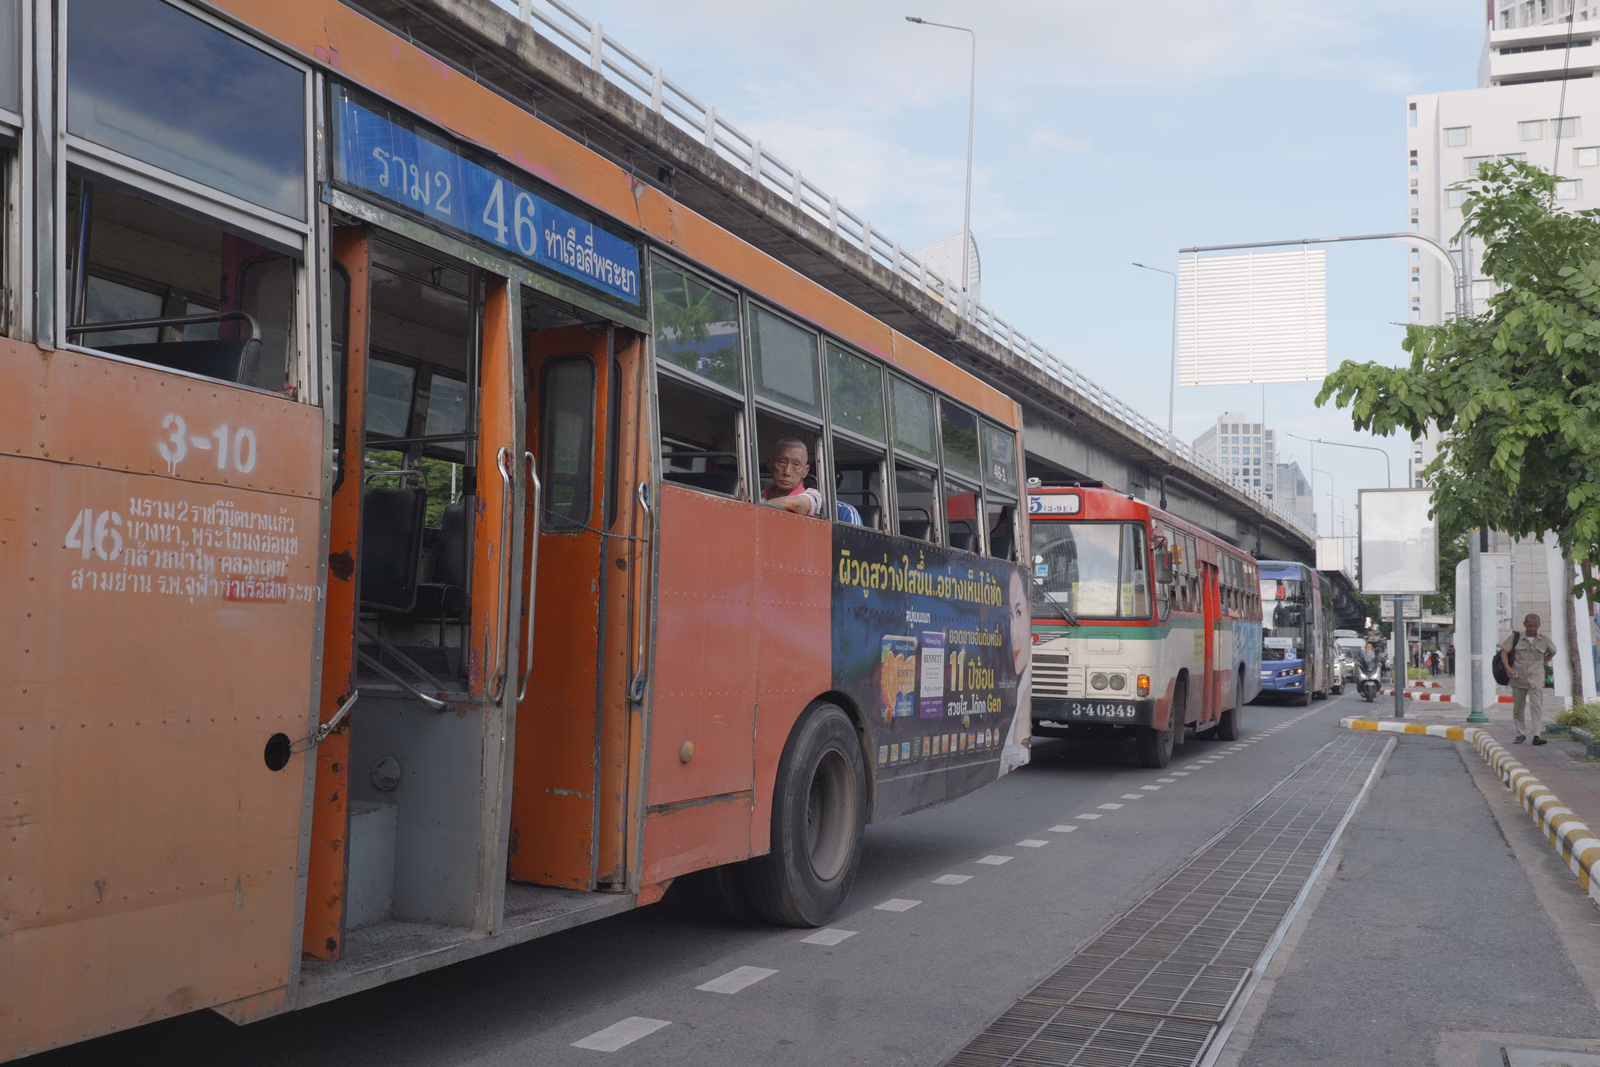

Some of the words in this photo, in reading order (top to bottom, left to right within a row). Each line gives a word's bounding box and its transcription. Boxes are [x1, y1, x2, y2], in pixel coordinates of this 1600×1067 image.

[372, 147, 451, 215] ราม2
[482, 178, 537, 256] 46
[545, 219, 636, 296] ท่าเรือสี่พระยา
[159, 414, 257, 475] 3-10
[65, 508, 122, 561] 46
[71, 567, 152, 594] สามย่าน
[1276, 584, 1286, 600] 4
[987, 693, 1002, 713] Gen
